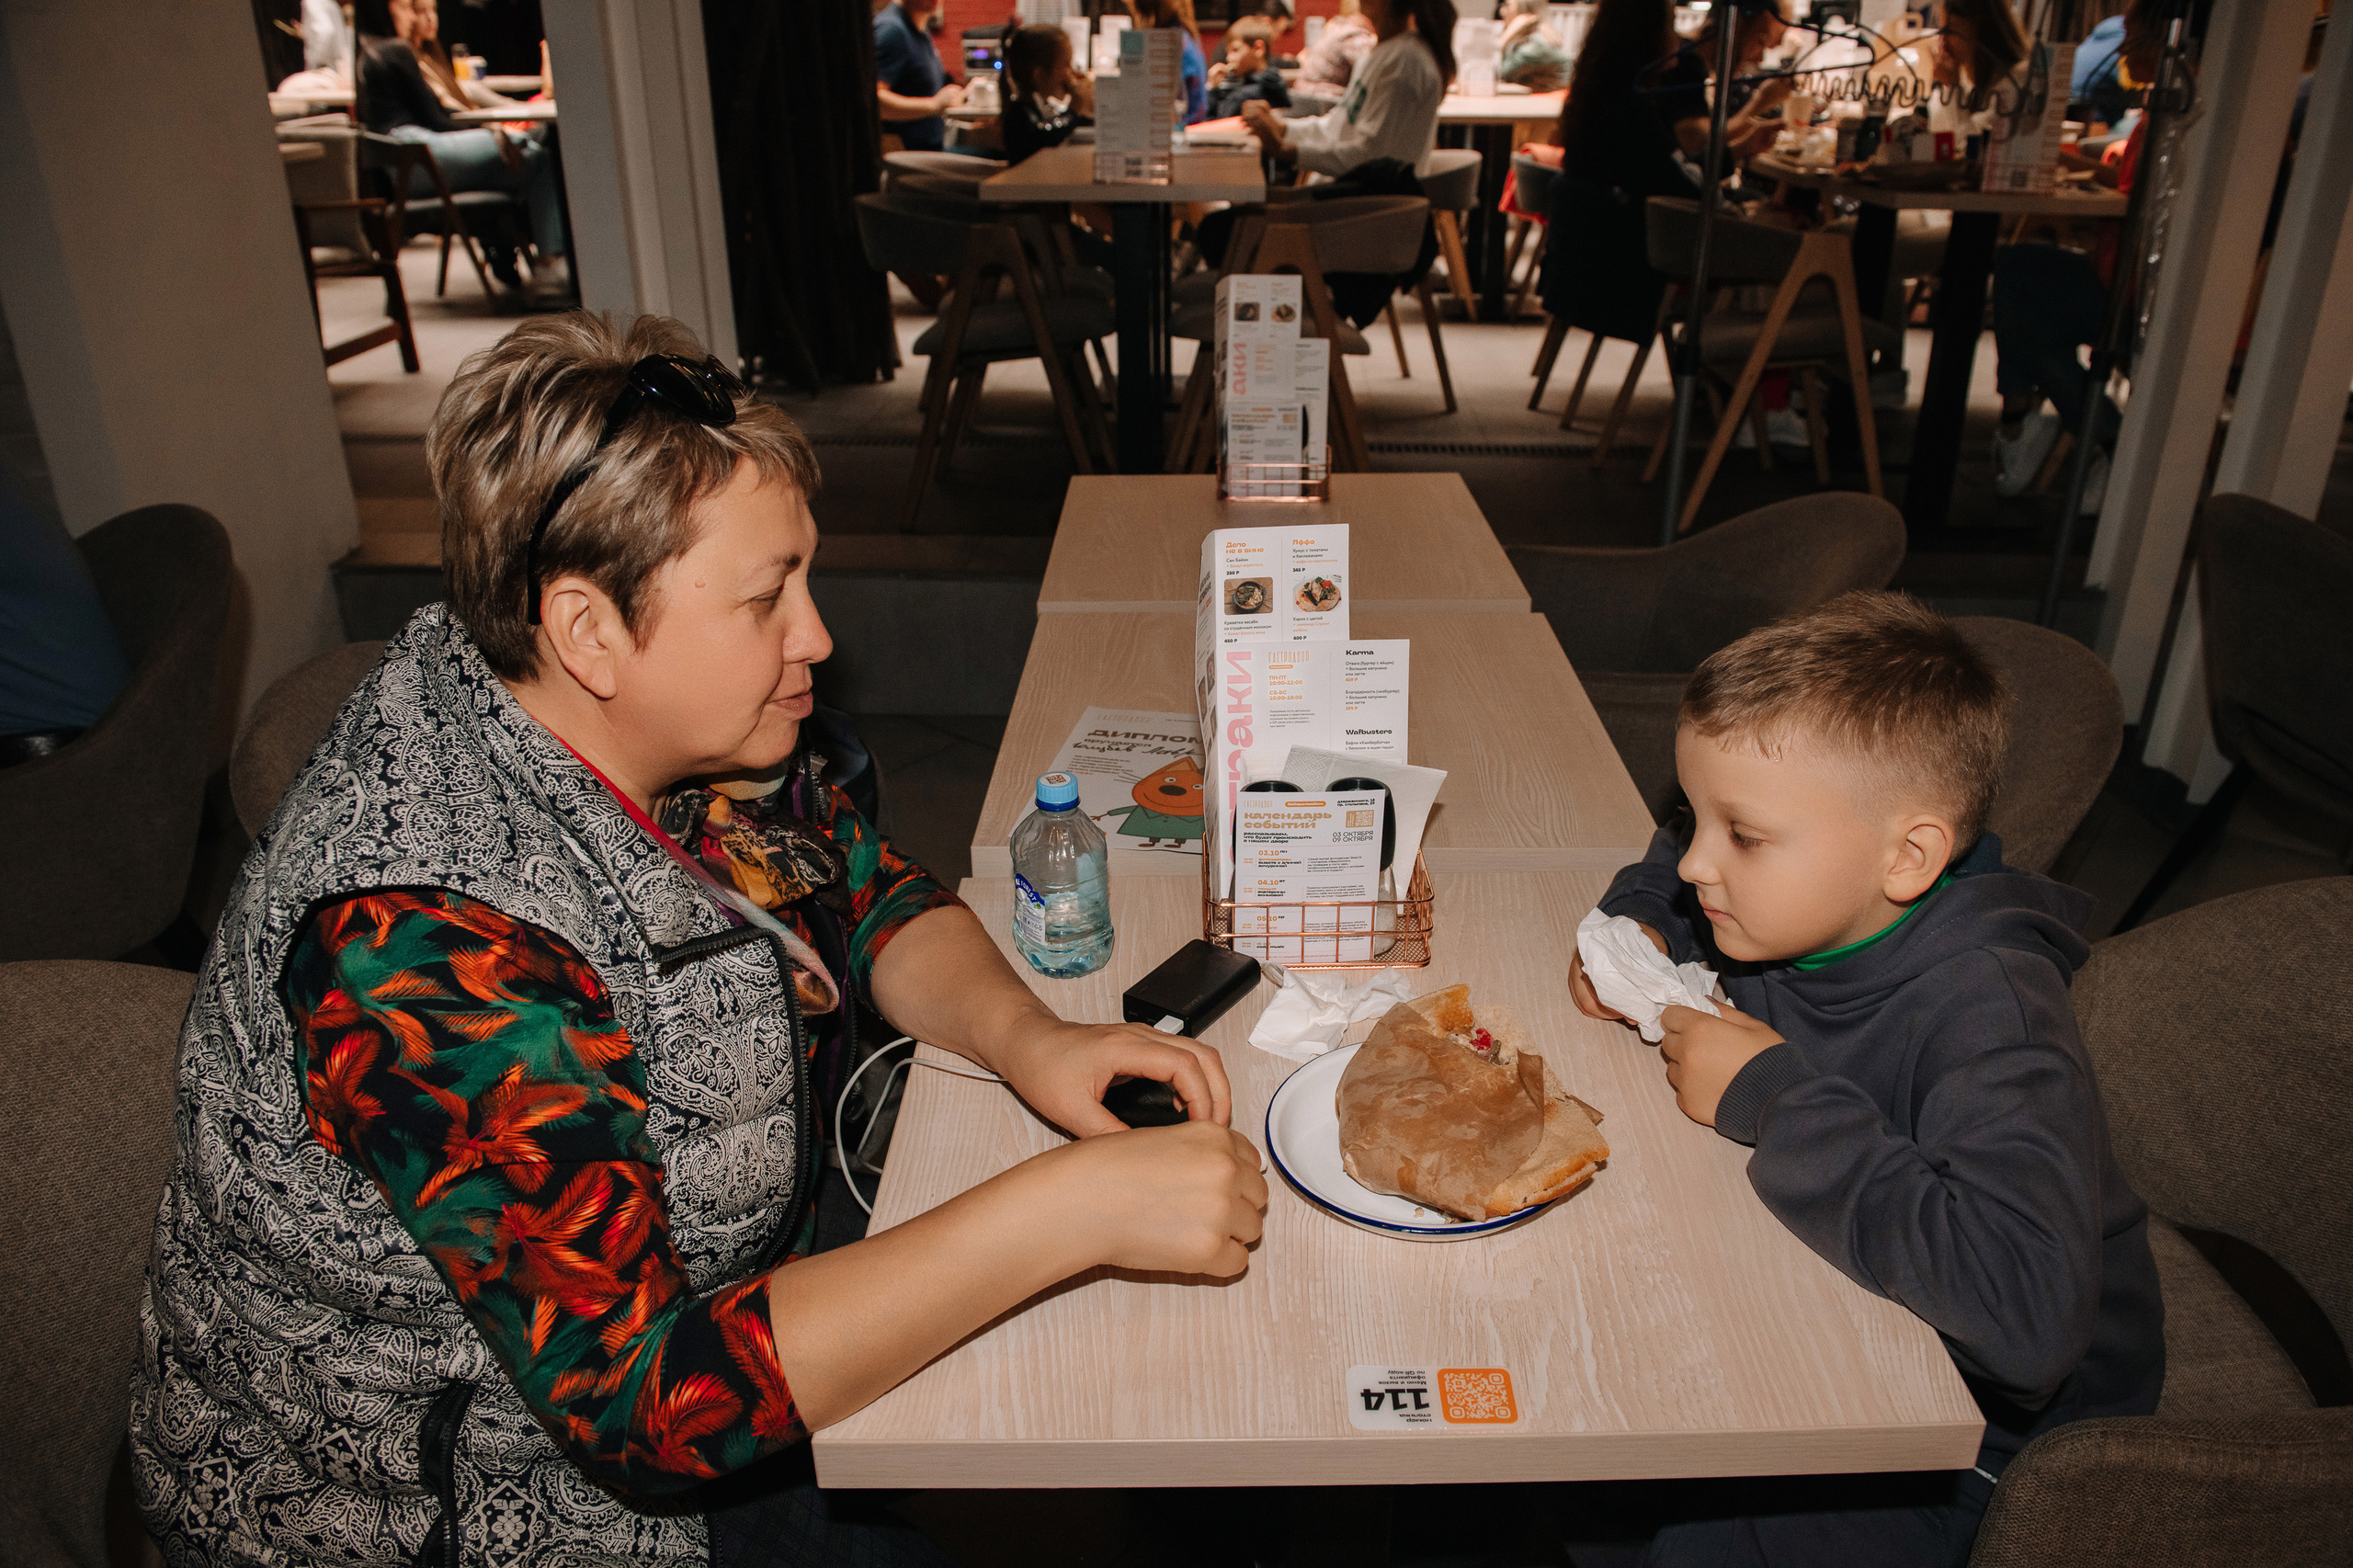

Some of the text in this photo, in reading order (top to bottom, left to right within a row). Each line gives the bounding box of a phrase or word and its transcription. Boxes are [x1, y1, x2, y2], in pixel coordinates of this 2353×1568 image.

[1268, 650, 1310, 664] ГАСТРОДВОР
[1244, 812, 1333, 822] календарь
[1244, 819, 1316, 829] событий
[1360, 1388, 1429, 1411] 114
